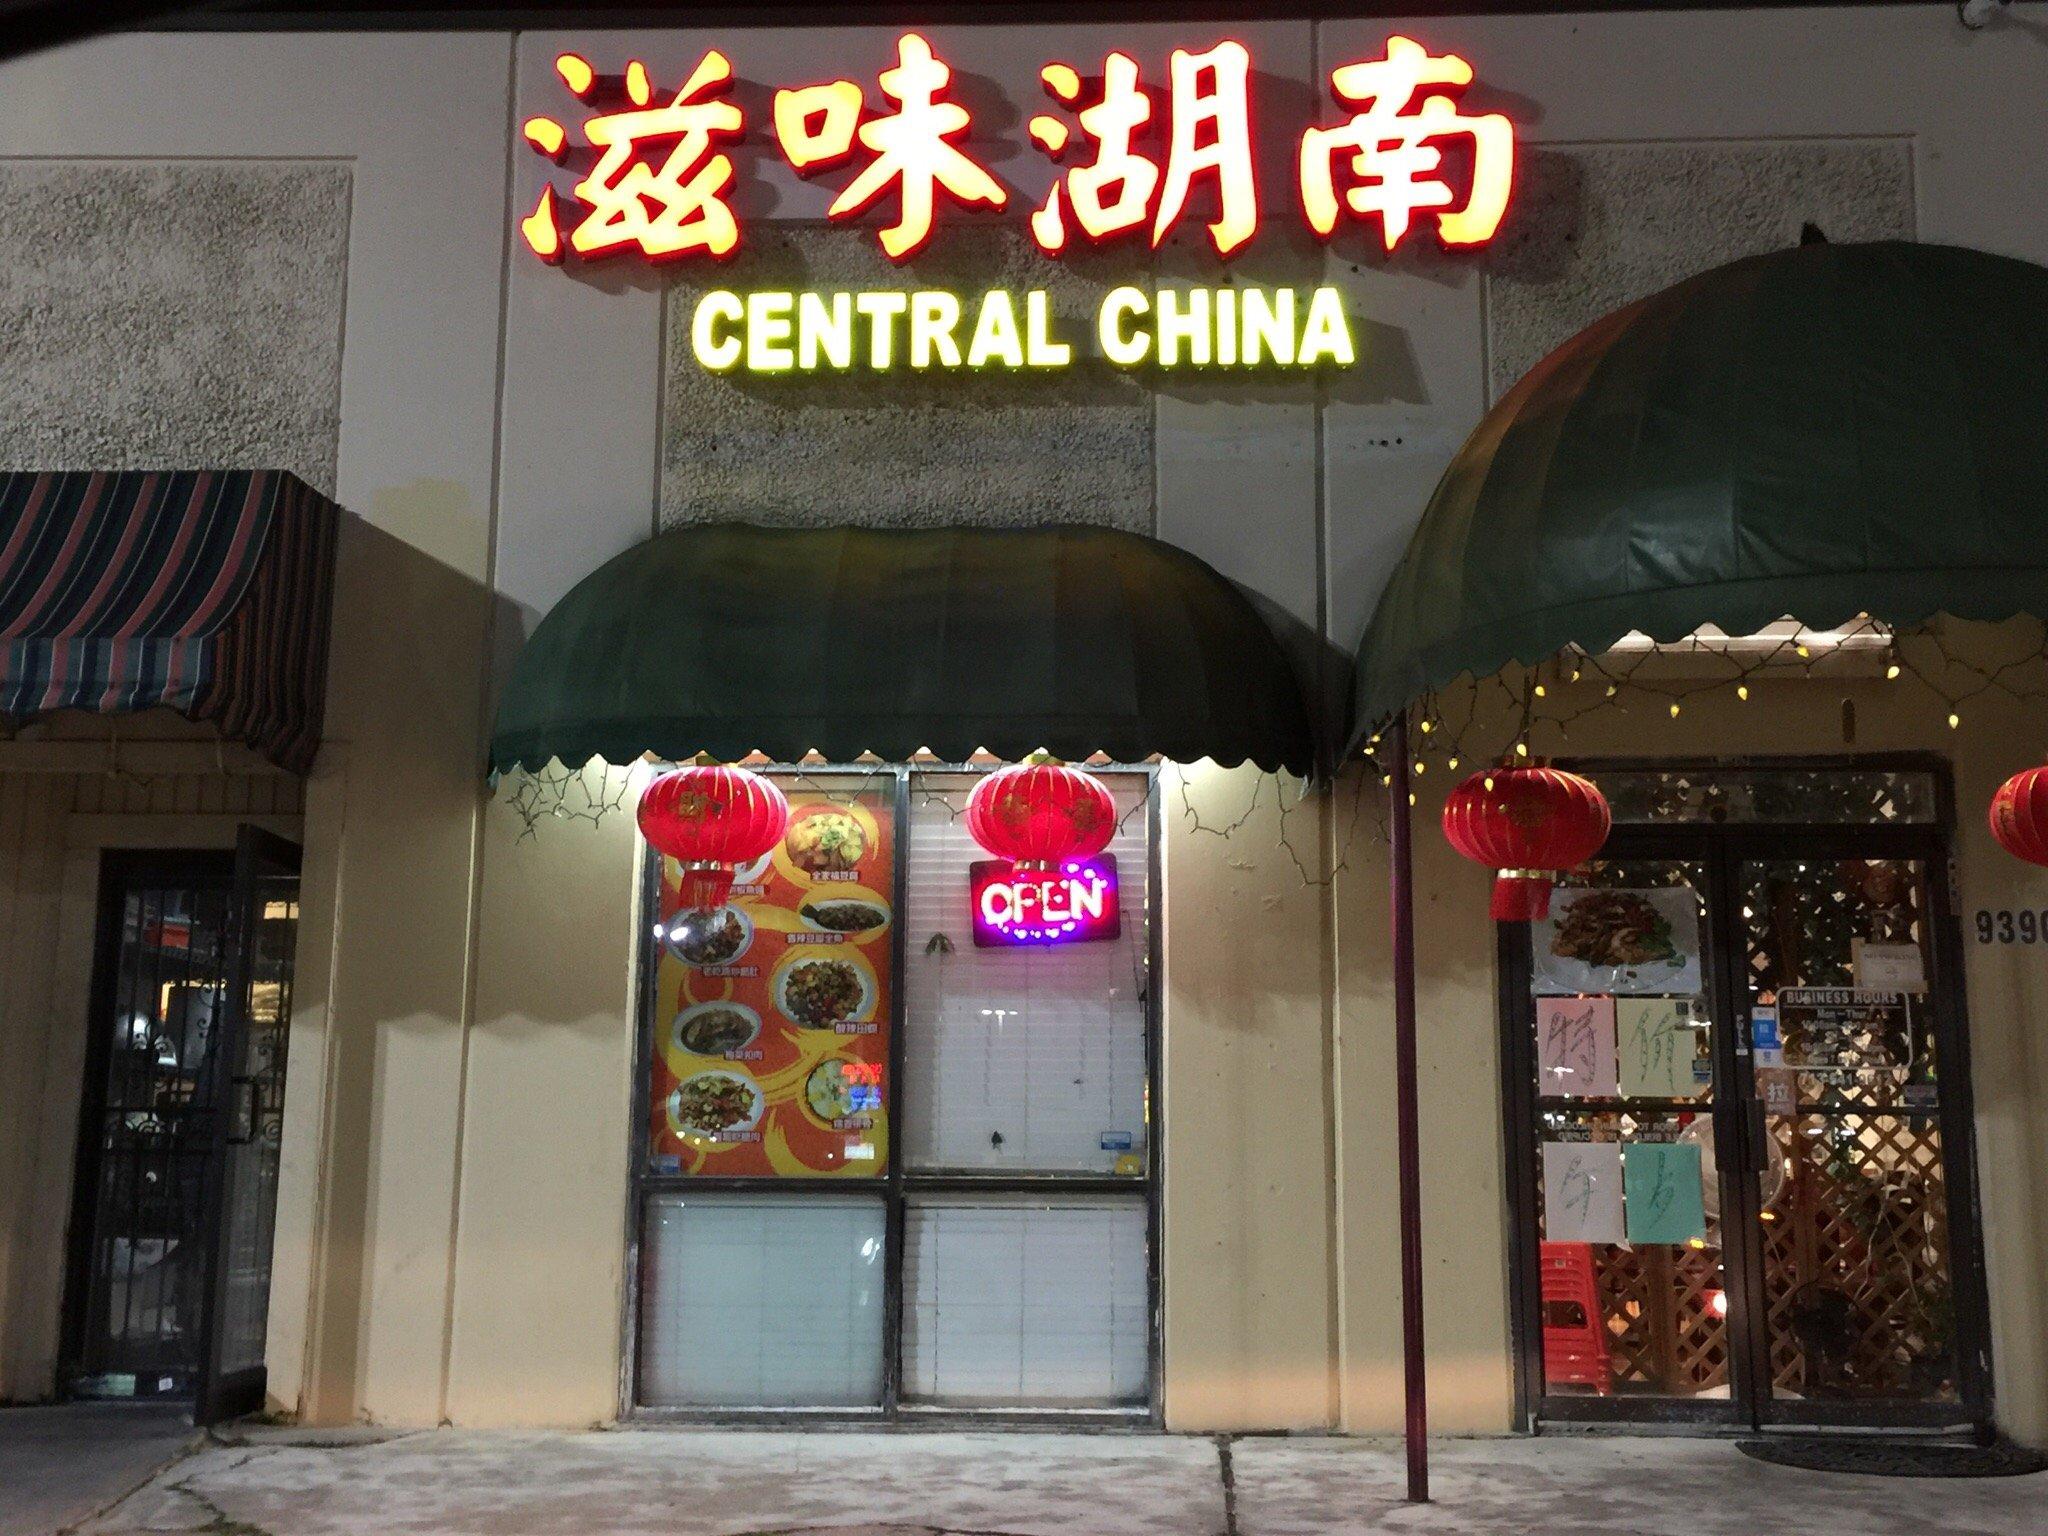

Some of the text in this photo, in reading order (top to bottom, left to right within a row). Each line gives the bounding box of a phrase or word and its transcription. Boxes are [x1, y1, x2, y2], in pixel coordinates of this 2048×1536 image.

[521, 32, 1517, 259] 滋味湖南
[692, 286, 1356, 370] CENTRAL CHINA
[980, 878, 1104, 925] OPEN
[1786, 990, 1898, 1005] BUSINESS HOURS
